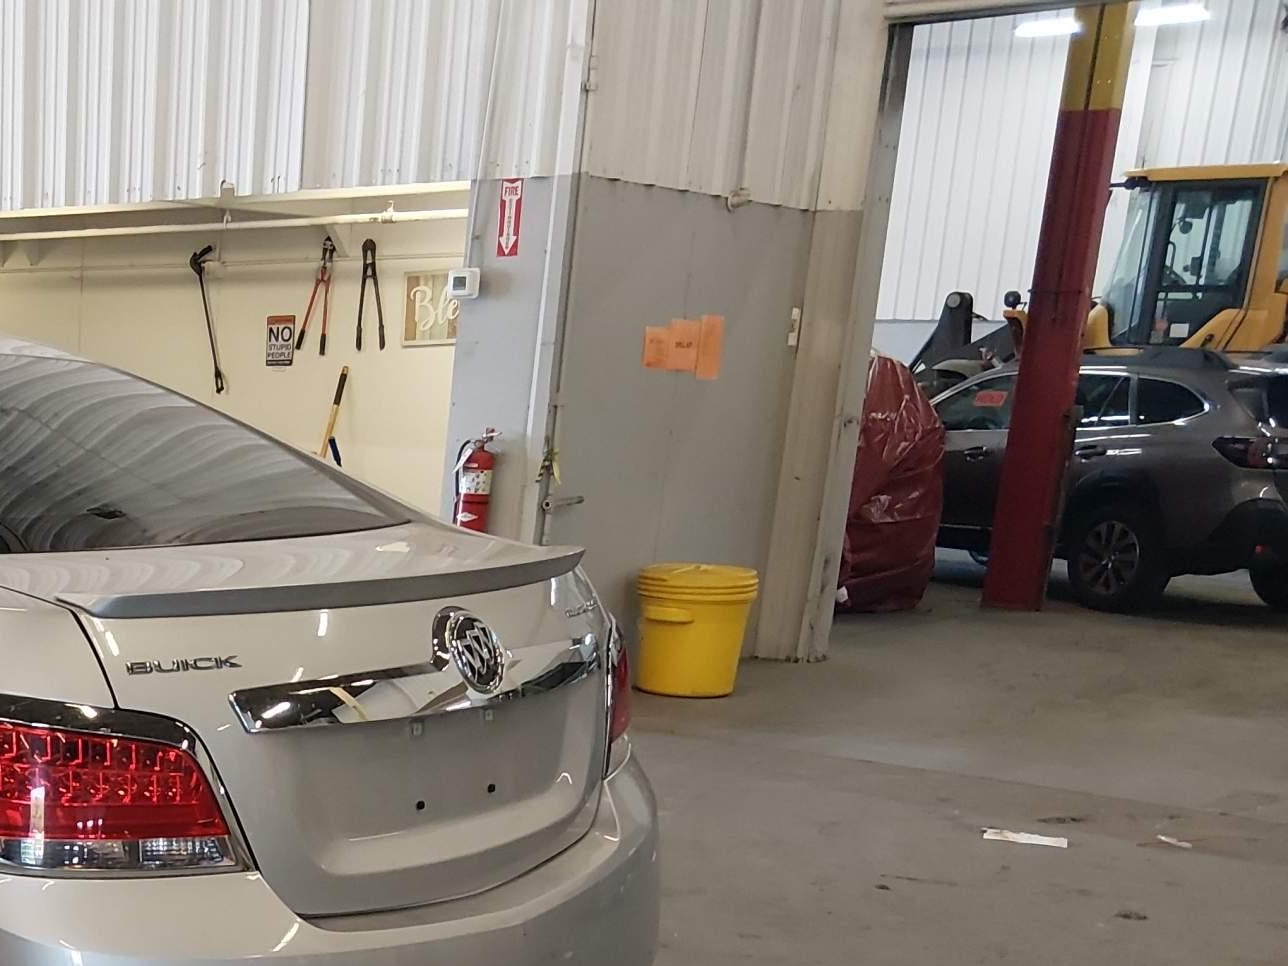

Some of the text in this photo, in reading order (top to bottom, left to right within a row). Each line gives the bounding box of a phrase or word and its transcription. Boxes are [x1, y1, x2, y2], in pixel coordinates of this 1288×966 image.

[504, 186, 519, 196] FIRE
[268, 326, 292, 343] NO
[268, 343, 291, 351] STUPID
[267, 351, 291, 359] PEOPLE
[125, 655, 242, 675] BUICK
